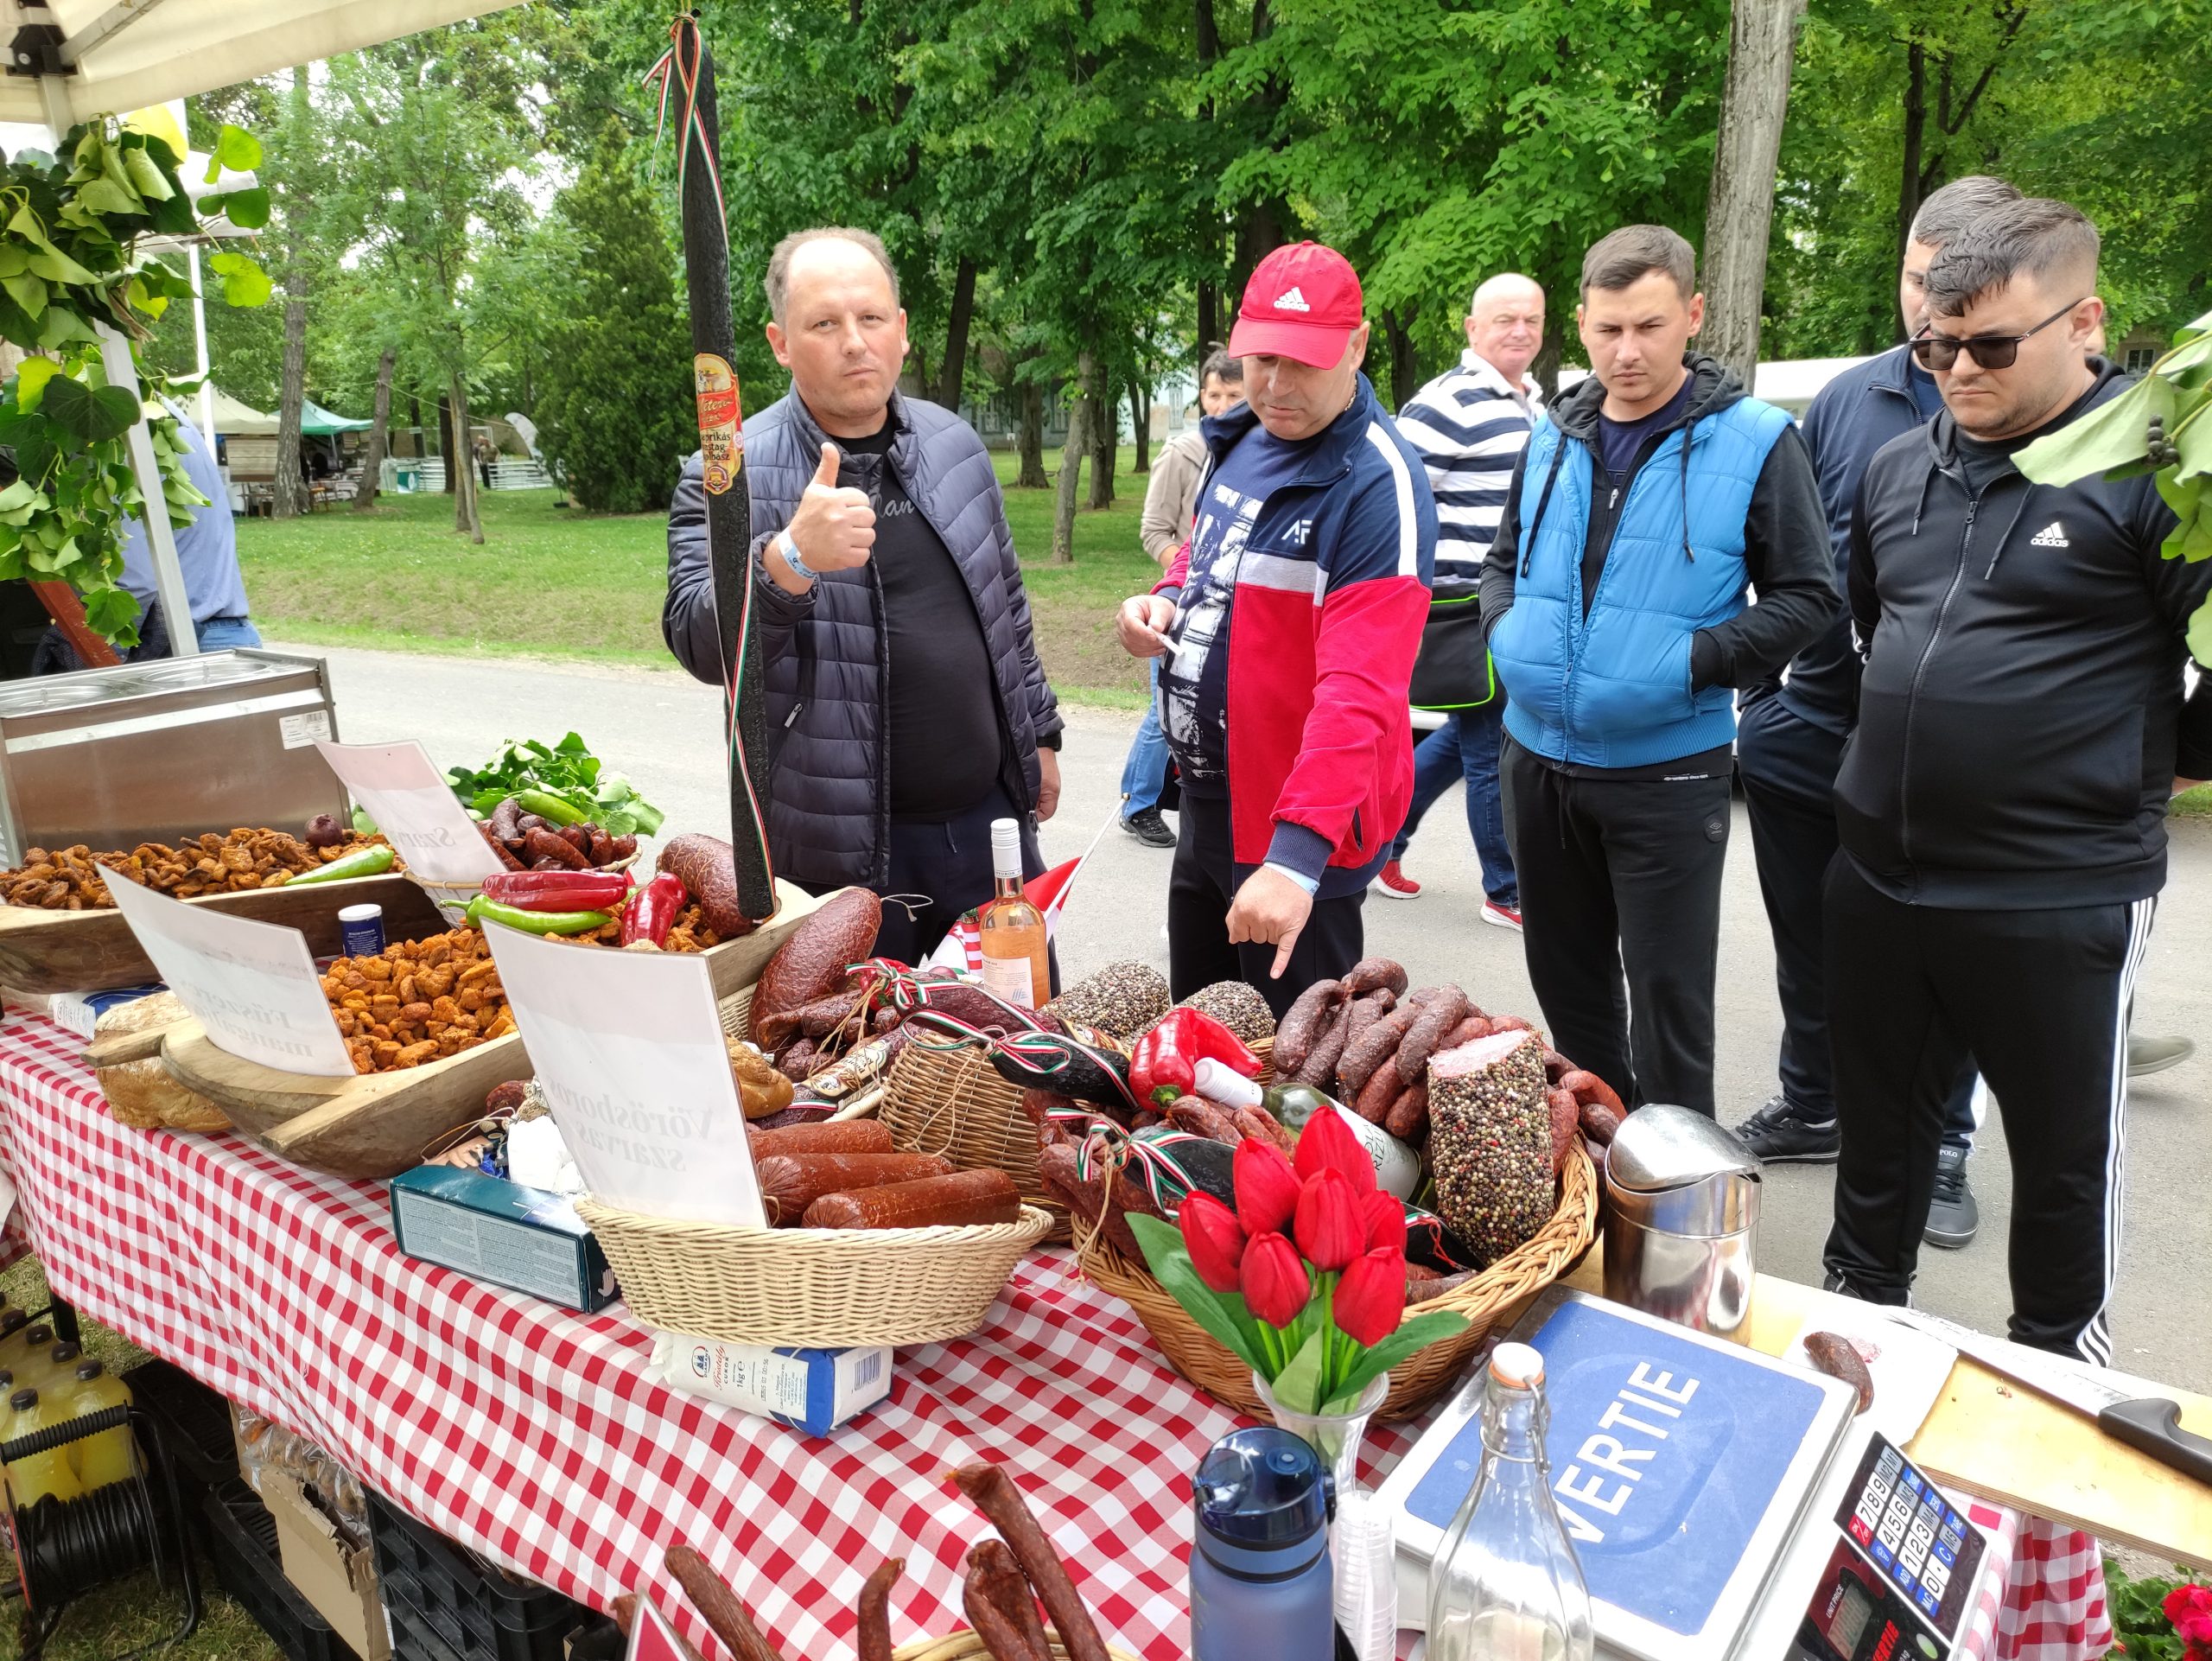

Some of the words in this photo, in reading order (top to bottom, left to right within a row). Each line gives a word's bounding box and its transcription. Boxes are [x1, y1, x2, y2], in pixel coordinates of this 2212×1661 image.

[701, 432, 731, 443] aprikás
[875, 493, 915, 519] lan
[2031, 538, 2069, 547] adidas
[714, 1345, 726, 1391] Kristály
[1554, 1361, 1700, 1543] VERTIE
[1886, 1453, 1899, 1467] M1
[1880, 1465, 1893, 1483] M2
[1873, 1478, 1886, 1493] 9
[1867, 1492, 1880, 1507] 8
[1902, 1486, 1915, 1503] M3
[1859, 1506, 1873, 1523] 7
[1895, 1500, 1908, 1517] 6
[1923, 1508, 1936, 1526] M4
[1889, 1515, 1902, 1531] 5
[1917, 1524, 1929, 1539] 3
[1883, 1529, 1896, 1545] 4
[1944, 1530, 1958, 1550] M5
[1911, 1538, 1923, 1555] 2
[1938, 1547, 1952, 1561] C
[1904, 1553, 1917, 1569] 1
[1899, 1569, 1911, 1588] ADD
[1927, 1576, 1940, 1594] 0
[1826, 1600, 1838, 1619] UNIT
[1833, 1583, 1844, 1605] PRICE
